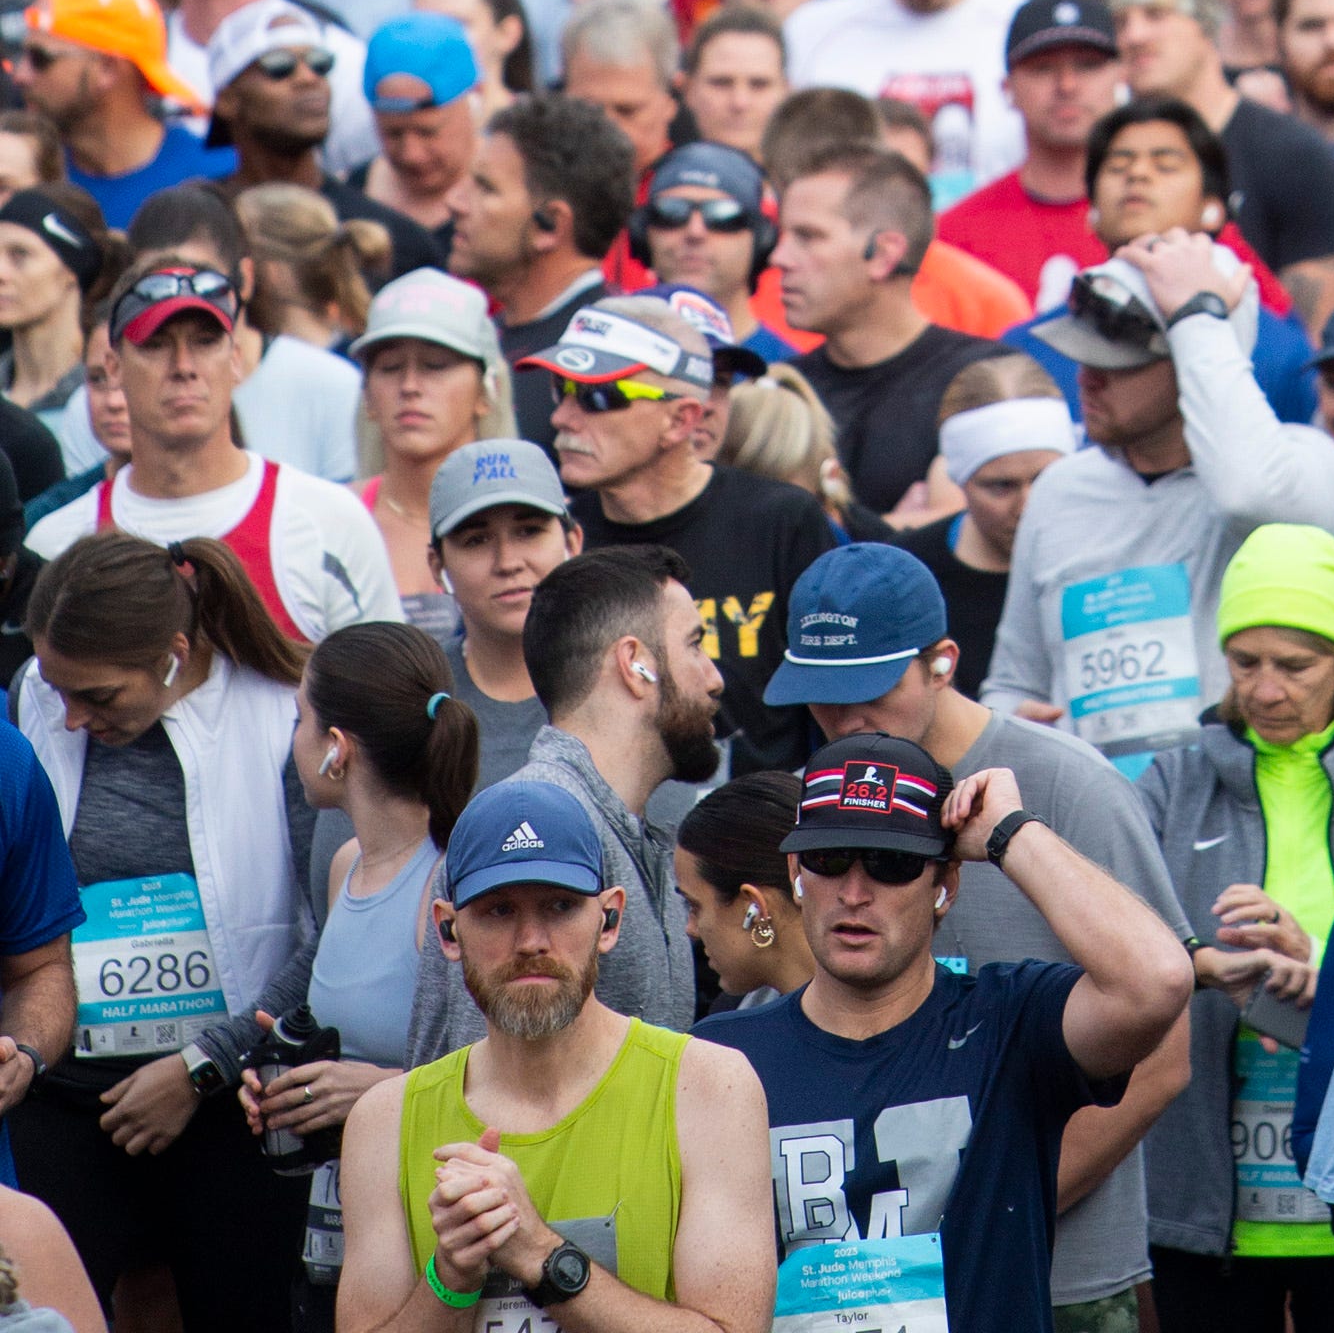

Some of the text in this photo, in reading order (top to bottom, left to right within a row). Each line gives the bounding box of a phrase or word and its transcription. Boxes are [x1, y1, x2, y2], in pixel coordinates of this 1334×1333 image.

[475, 453, 511, 470] RUN
[1081, 640, 1167, 690] 5962
[845, 782, 888, 801] 26.2
[843, 797, 887, 810] FINISHER
[501, 838, 545, 852] adidas
[99, 950, 211, 997] 6286
[102, 996, 217, 1018] HALF MARATHON
[802, 1256, 897, 1276] St. Jude Memphis
[800, 1268, 901, 1289] Marathon Weekend
[834, 1312, 869, 1325] Taylor
